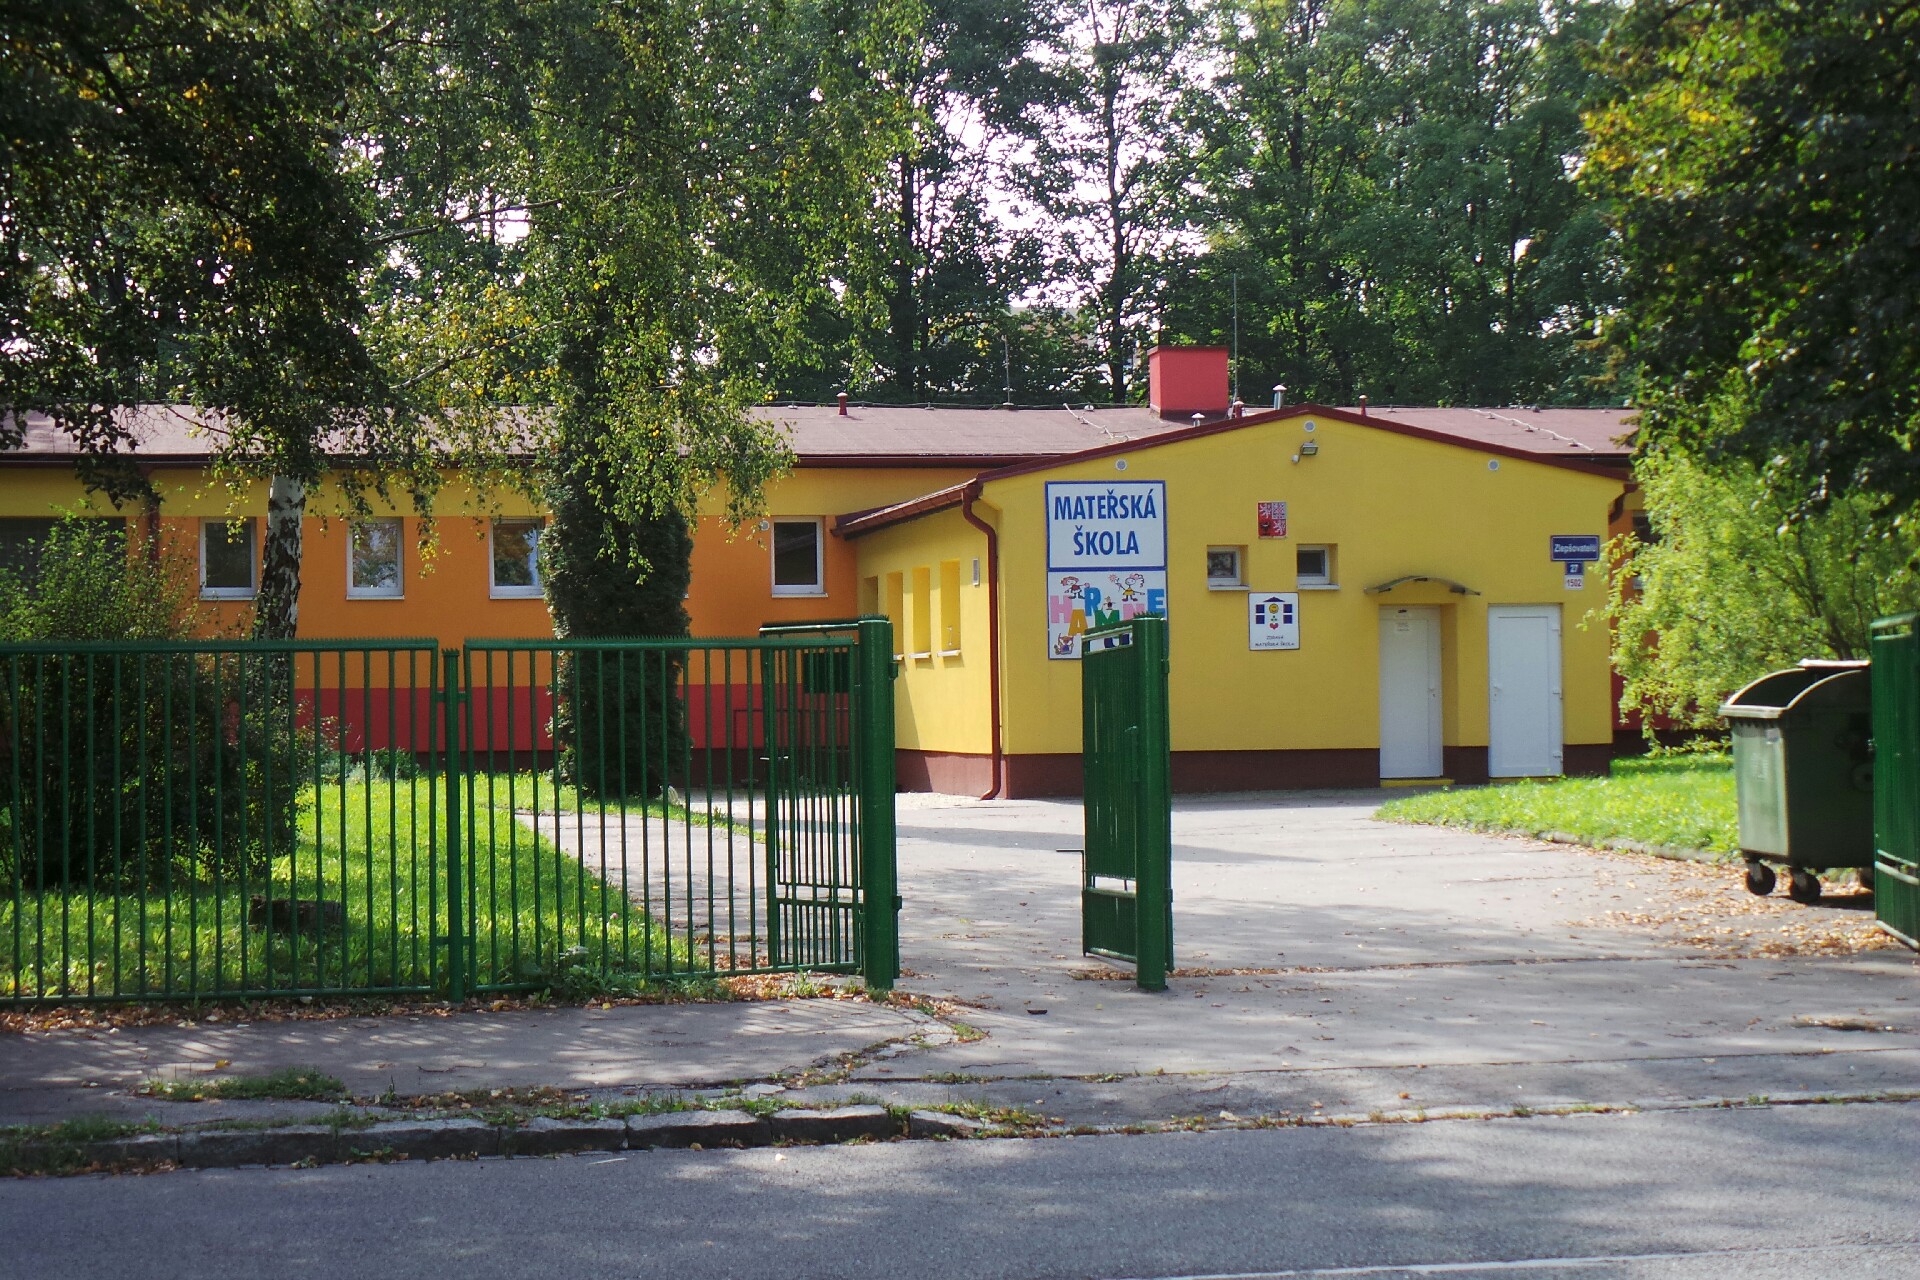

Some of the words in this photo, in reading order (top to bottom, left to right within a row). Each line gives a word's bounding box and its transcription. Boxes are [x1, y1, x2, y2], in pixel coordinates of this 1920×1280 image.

[1054, 488, 1157, 520] MATEŘSKÁ
[1073, 525, 1139, 556] ŠKOLA
[1570, 564, 1578, 573] 27
